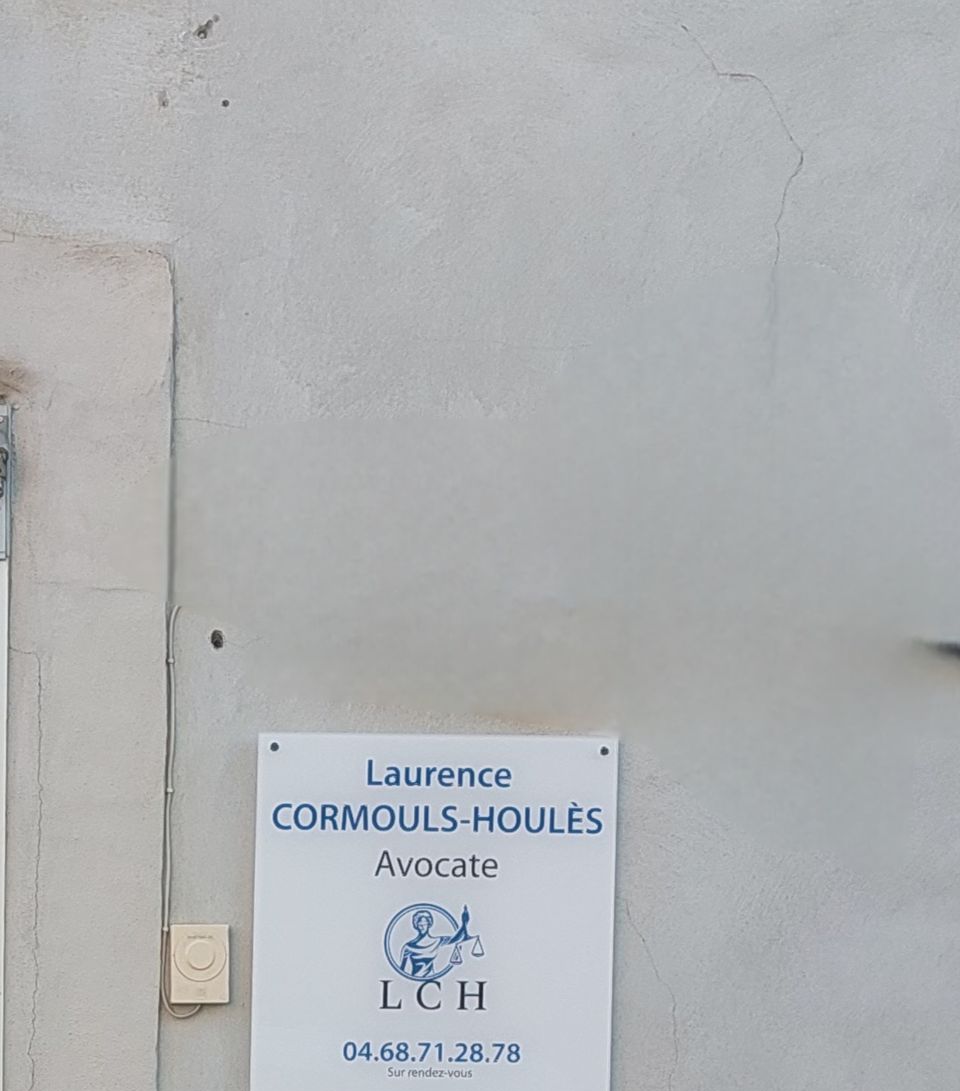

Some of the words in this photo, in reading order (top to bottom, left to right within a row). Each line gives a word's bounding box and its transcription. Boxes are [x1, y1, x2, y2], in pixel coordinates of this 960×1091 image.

[366, 759, 512, 788] Laurence
[271, 801, 604, 834] CORMOULS-HOULÈS
[374, 850, 498, 878] Avocate
[342, 1041, 521, 1063] 04.68.71.28.78
[387, 1067, 405, 1078] Sur
[407, 1067, 473, 1079] rendez-vous
